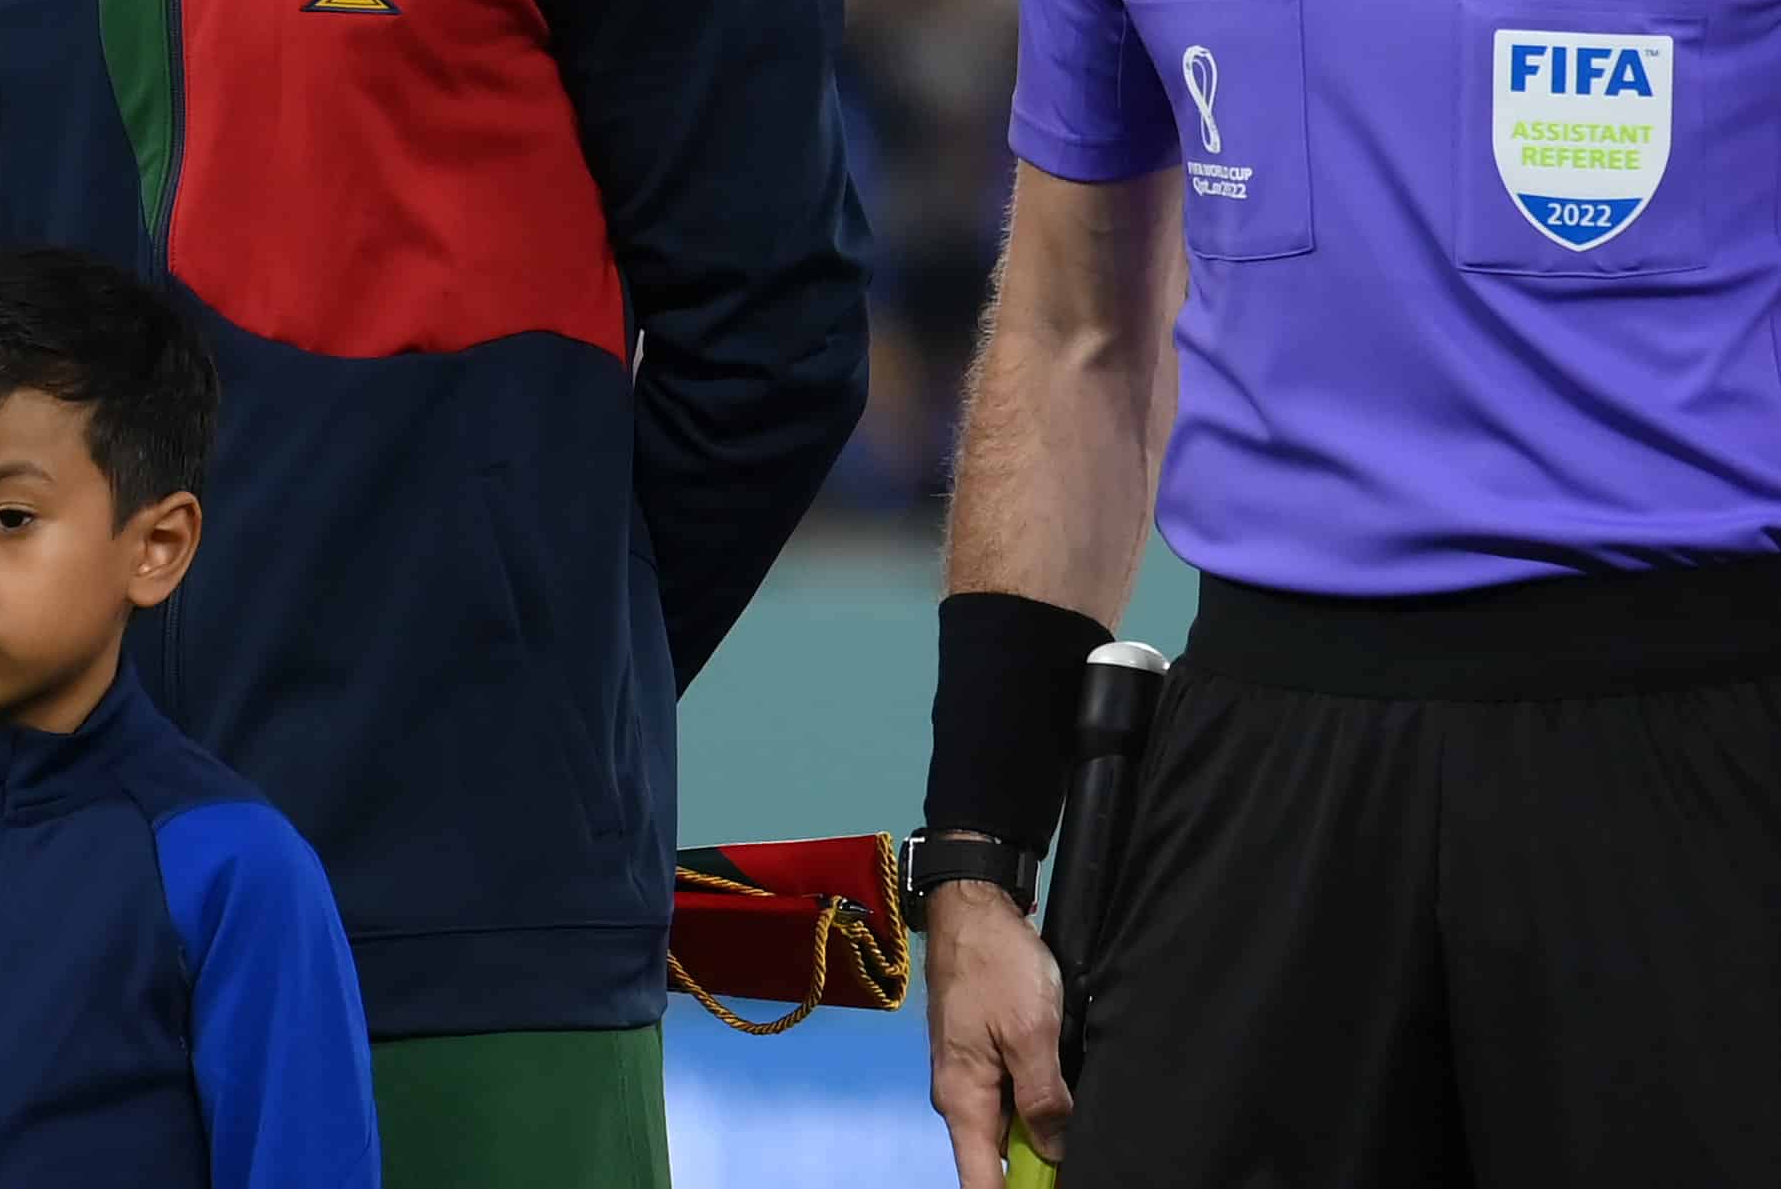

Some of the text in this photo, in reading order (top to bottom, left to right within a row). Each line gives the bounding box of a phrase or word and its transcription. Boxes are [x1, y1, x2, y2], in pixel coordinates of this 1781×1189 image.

[1511, 44, 1653, 97] FIFA
[1511, 121, 1654, 143] ASSISTANT
[1521, 146, 1642, 170] REFEREE
[1229, 167, 1253, 181] CUP
[1547, 202, 1612, 227] 2022
